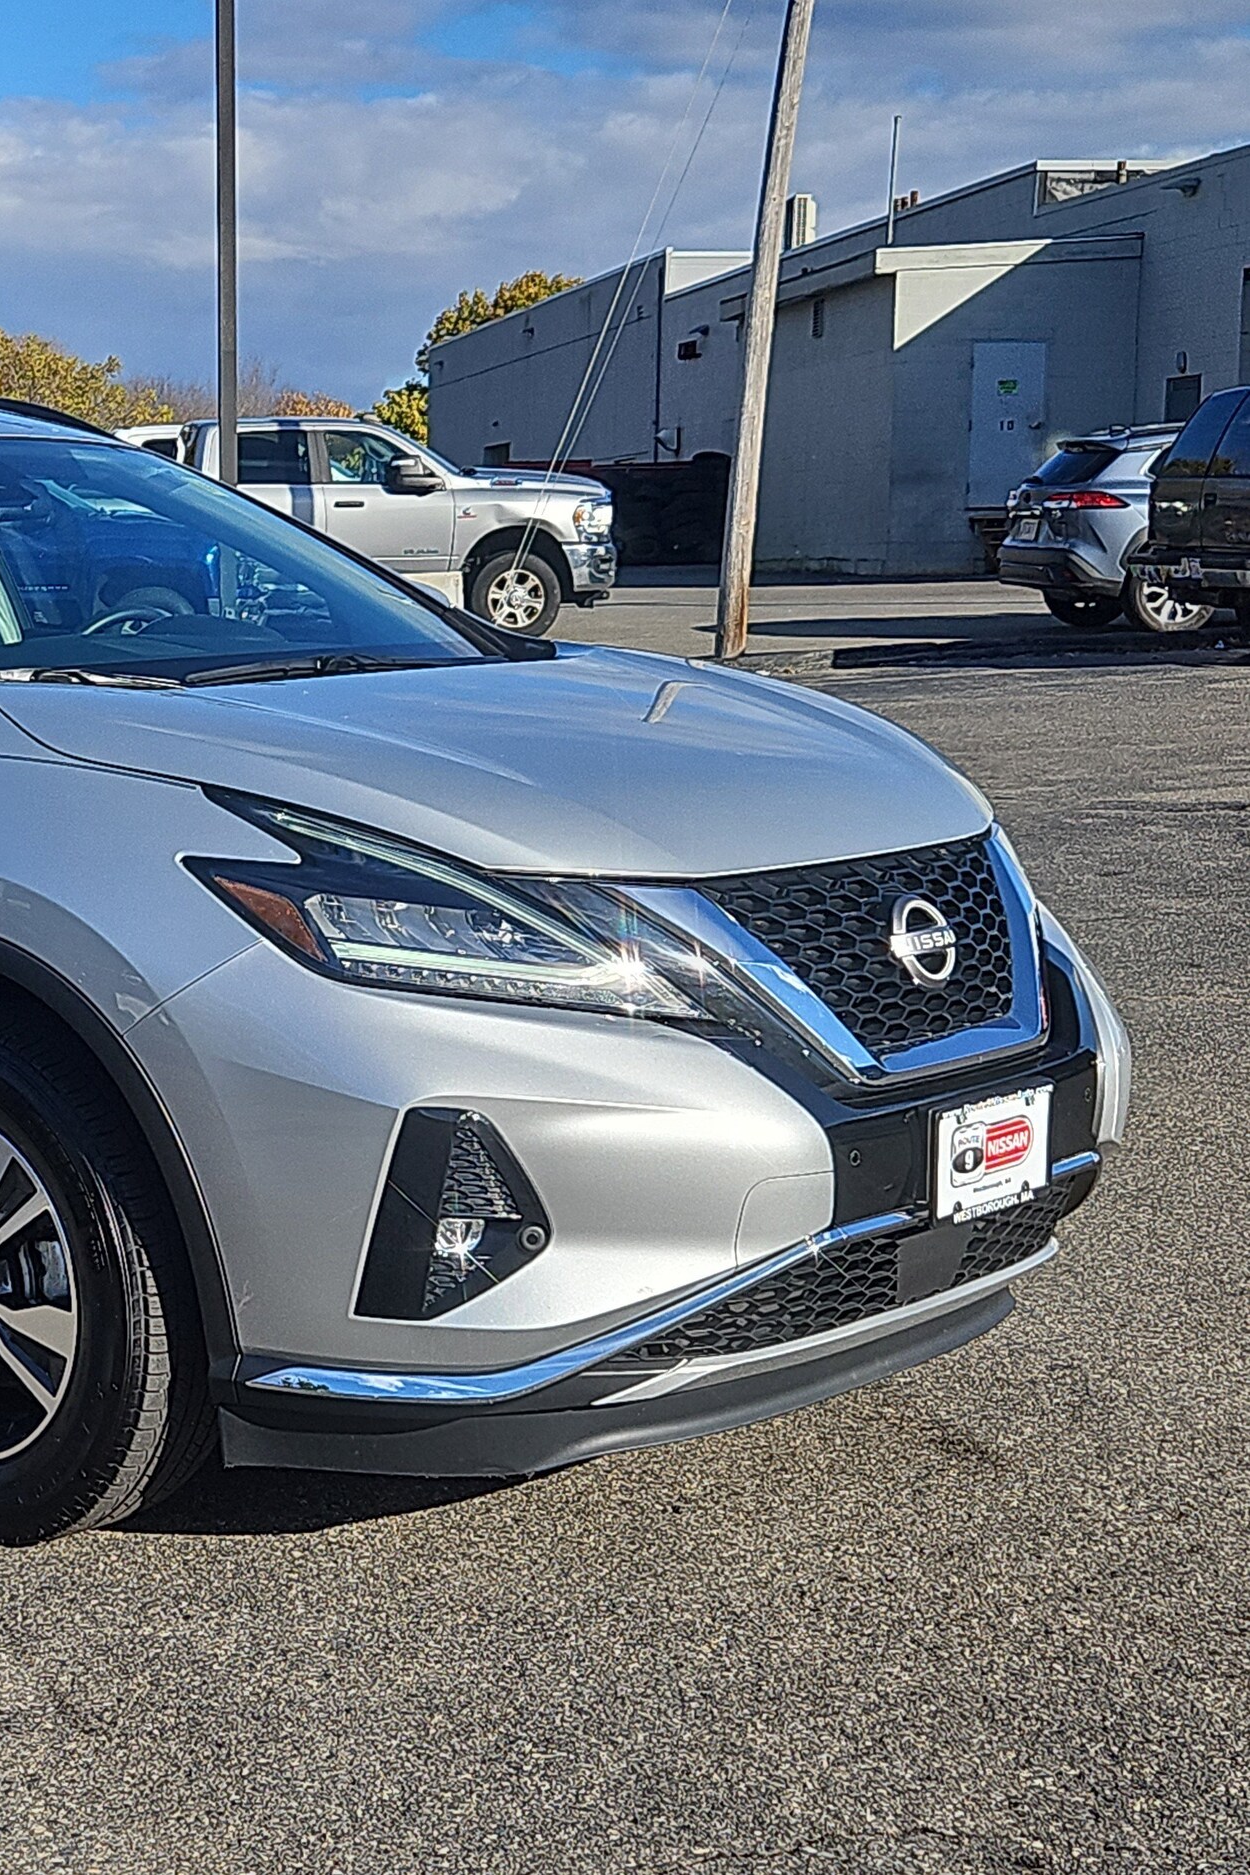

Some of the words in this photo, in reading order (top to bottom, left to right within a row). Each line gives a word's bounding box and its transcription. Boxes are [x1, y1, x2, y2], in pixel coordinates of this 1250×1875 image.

[999, 419, 1015, 432] 10
[957, 1134, 981, 1148] ROUTE
[987, 1130, 1029, 1157] NISSAN
[964, 1150, 975, 1171] 9
[1021, 1190, 1035, 1204] MA
